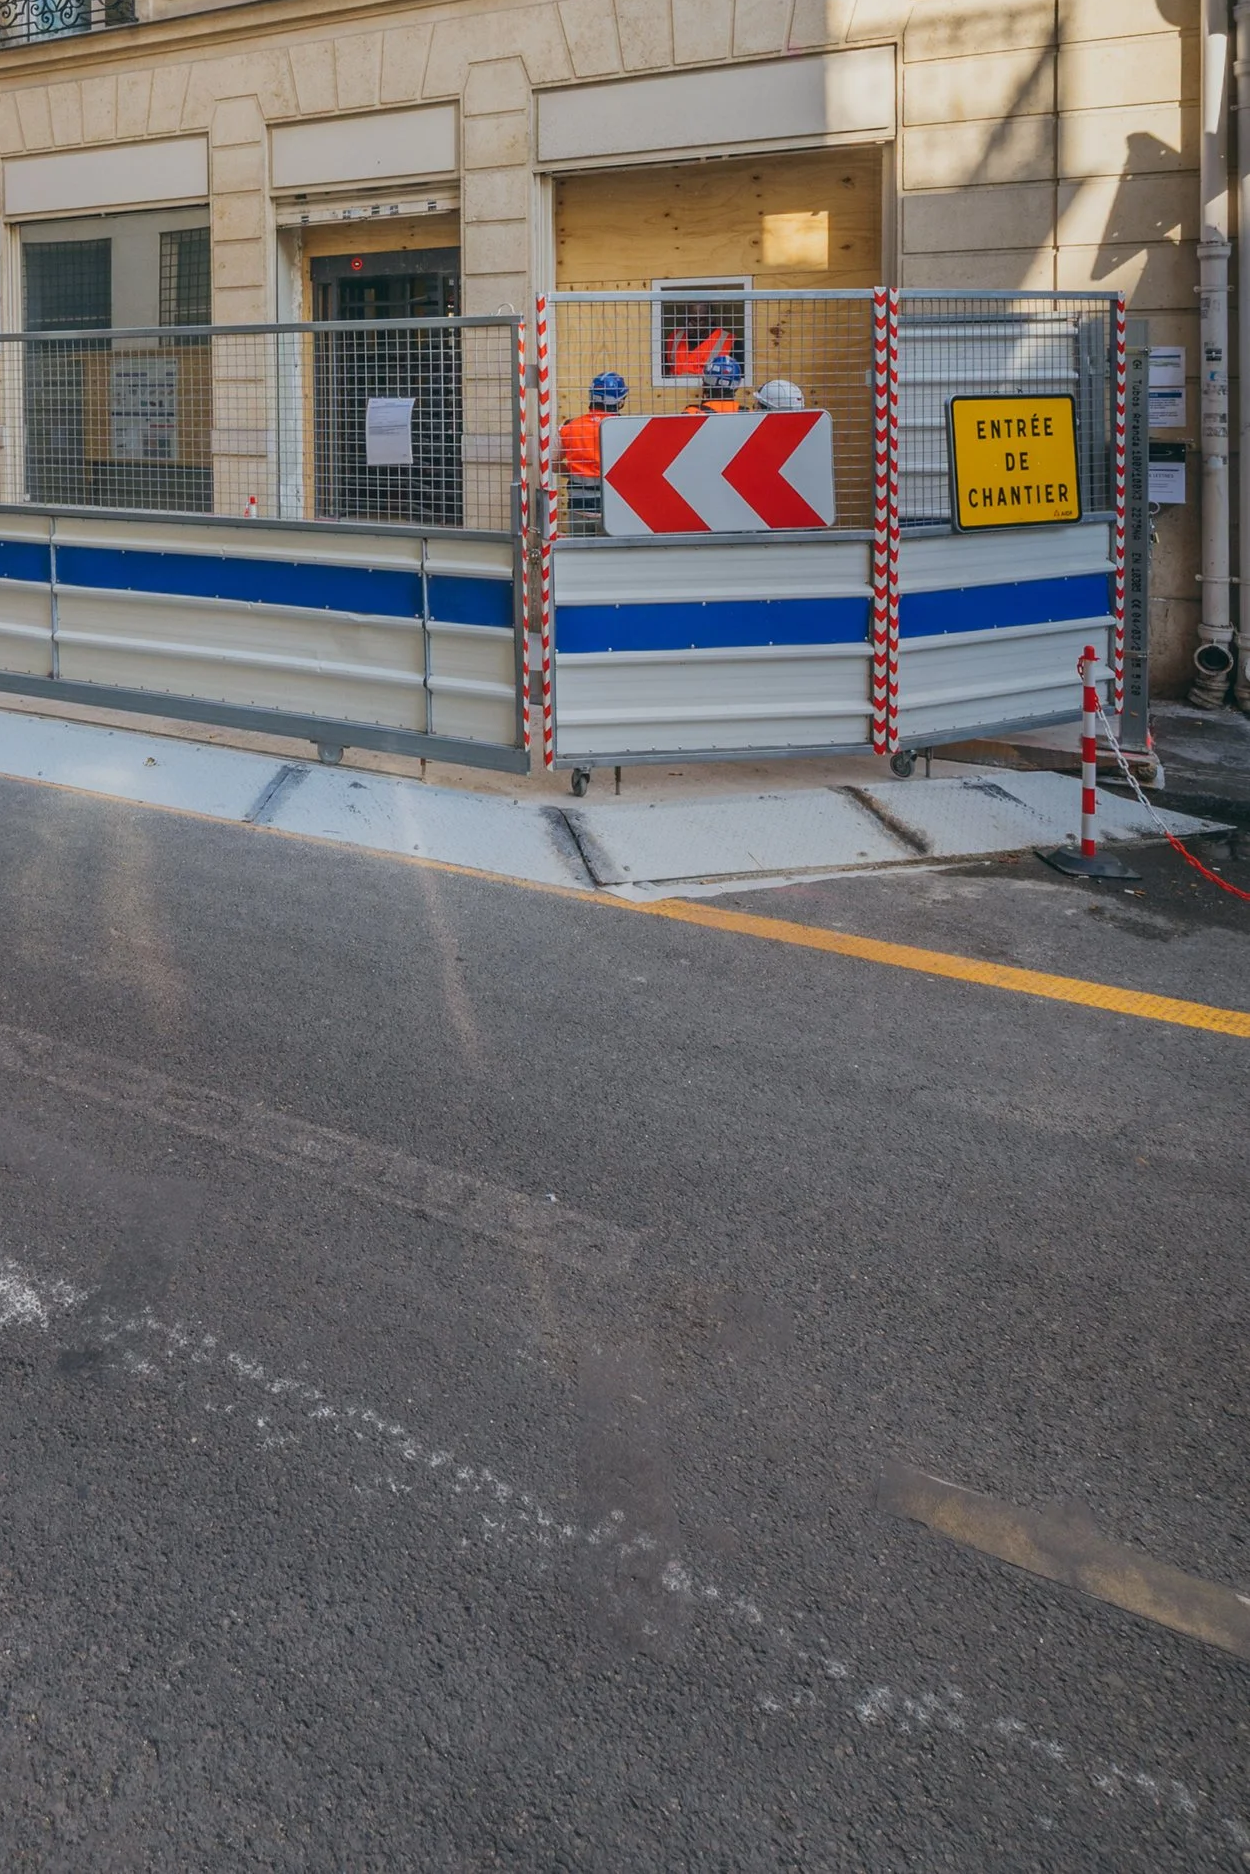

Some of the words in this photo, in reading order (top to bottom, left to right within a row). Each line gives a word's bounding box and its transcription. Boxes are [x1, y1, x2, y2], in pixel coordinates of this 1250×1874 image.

[1132, 379, 1143, 407] Tubos
[976, 413, 1054, 440] ENTRÉE
[1132, 413, 1143, 447] Aranda
[1005, 451, 1030, 472] DE
[968, 483, 1069, 508] CHANTIER
